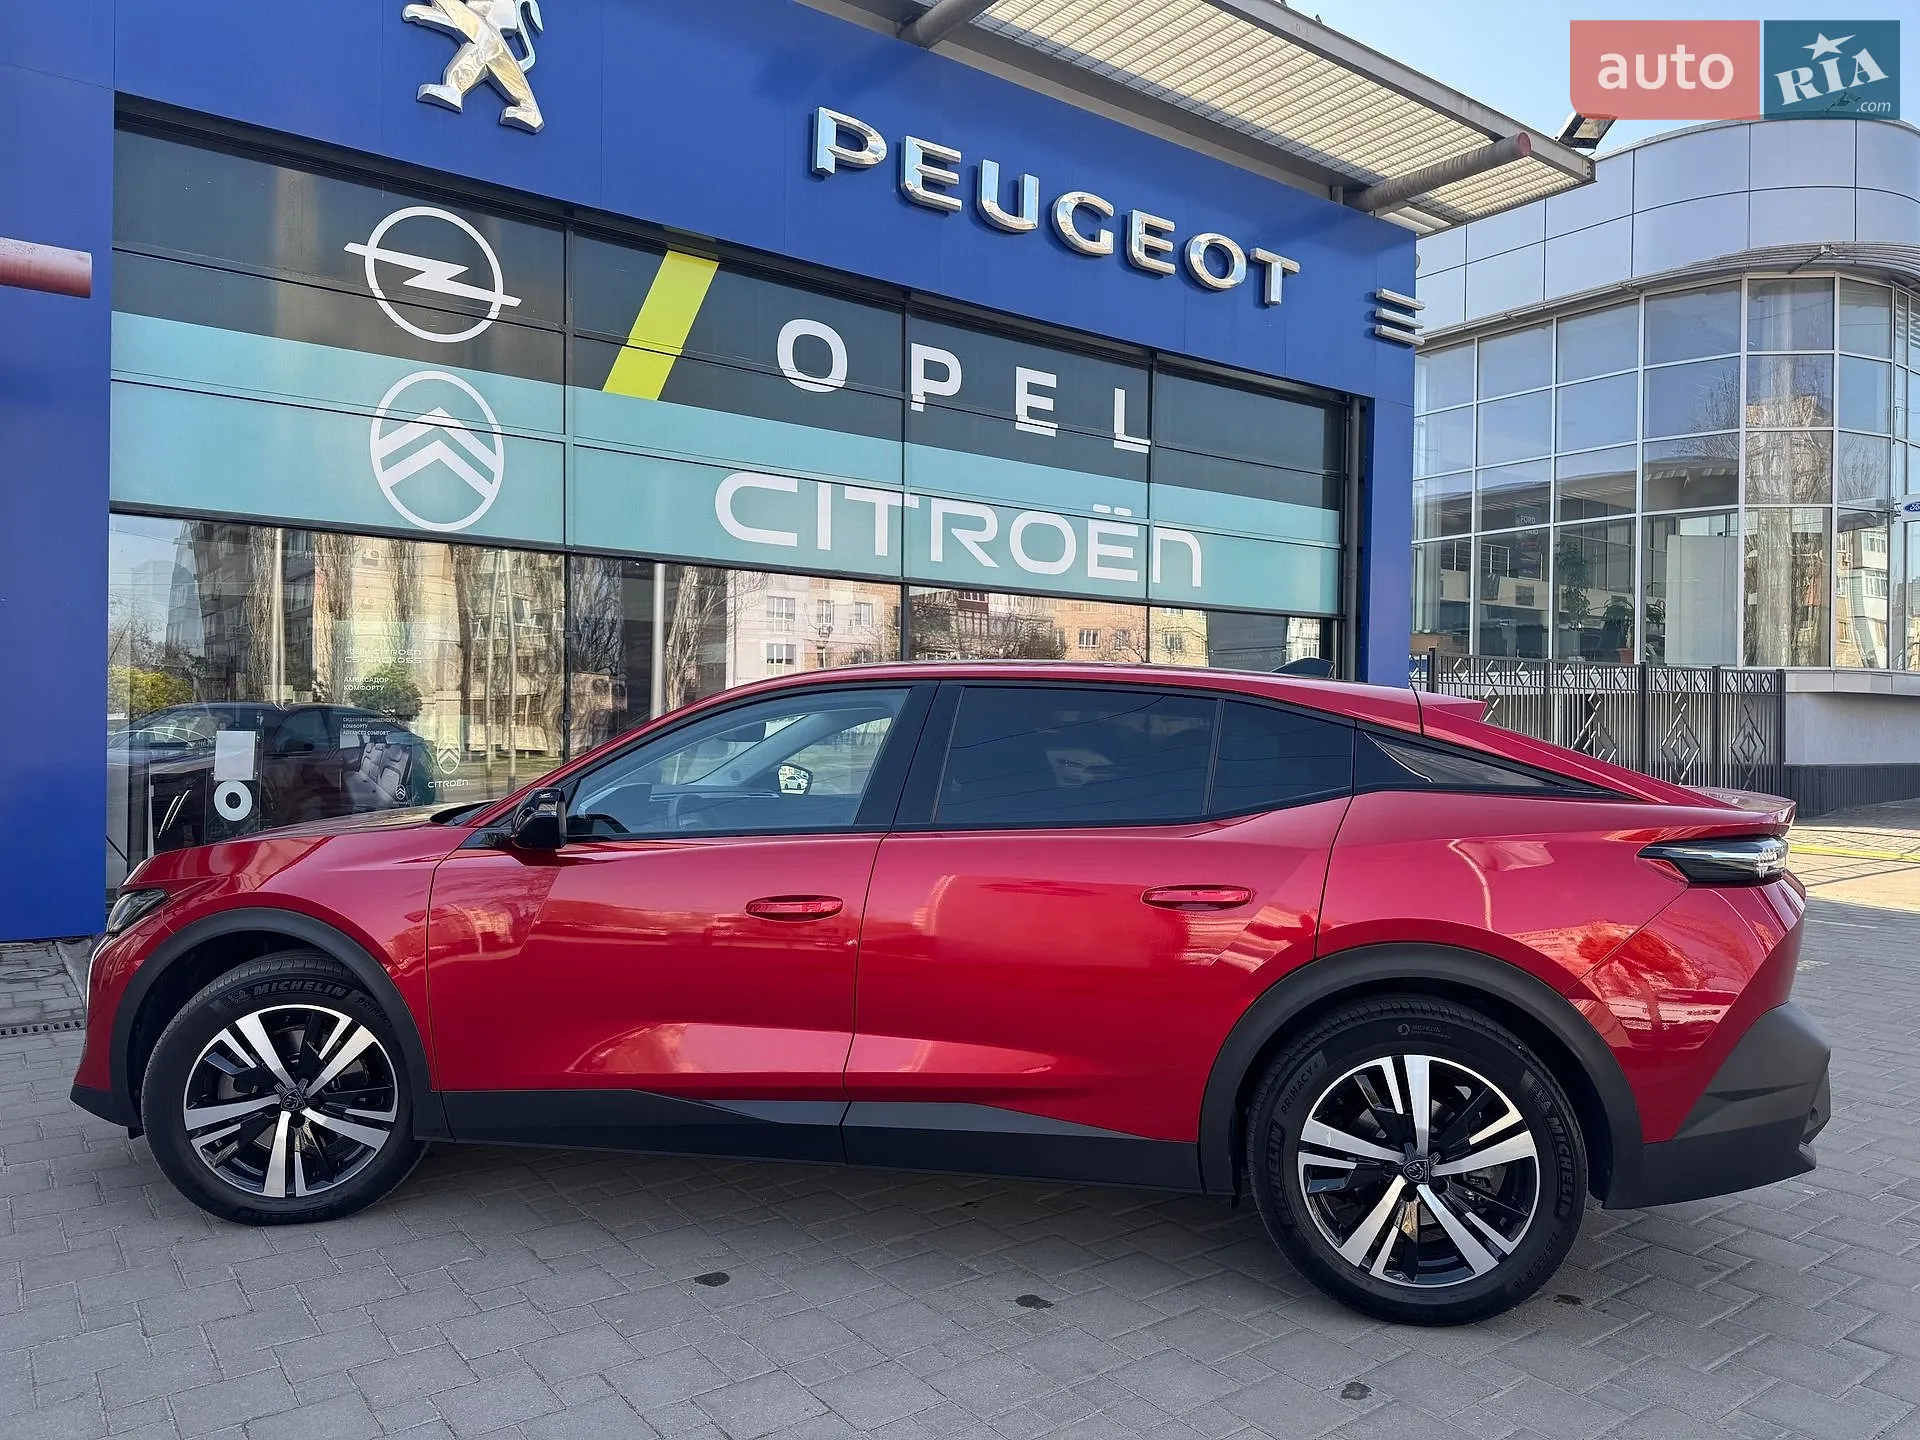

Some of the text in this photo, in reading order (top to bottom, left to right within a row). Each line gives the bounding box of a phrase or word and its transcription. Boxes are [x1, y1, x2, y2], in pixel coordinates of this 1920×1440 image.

[814, 106, 1300, 305] PEUGEOT
[777, 318, 1150, 454] OPEL
[715, 472, 1201, 588] CITROËN
[343, 676, 389, 684] АМБАСАДОР
[253, 980, 348, 999] MICHELIN
[1280, 1065, 1314, 1115] PRIMACY
[1547, 1115, 1575, 1216] MICHELIN
